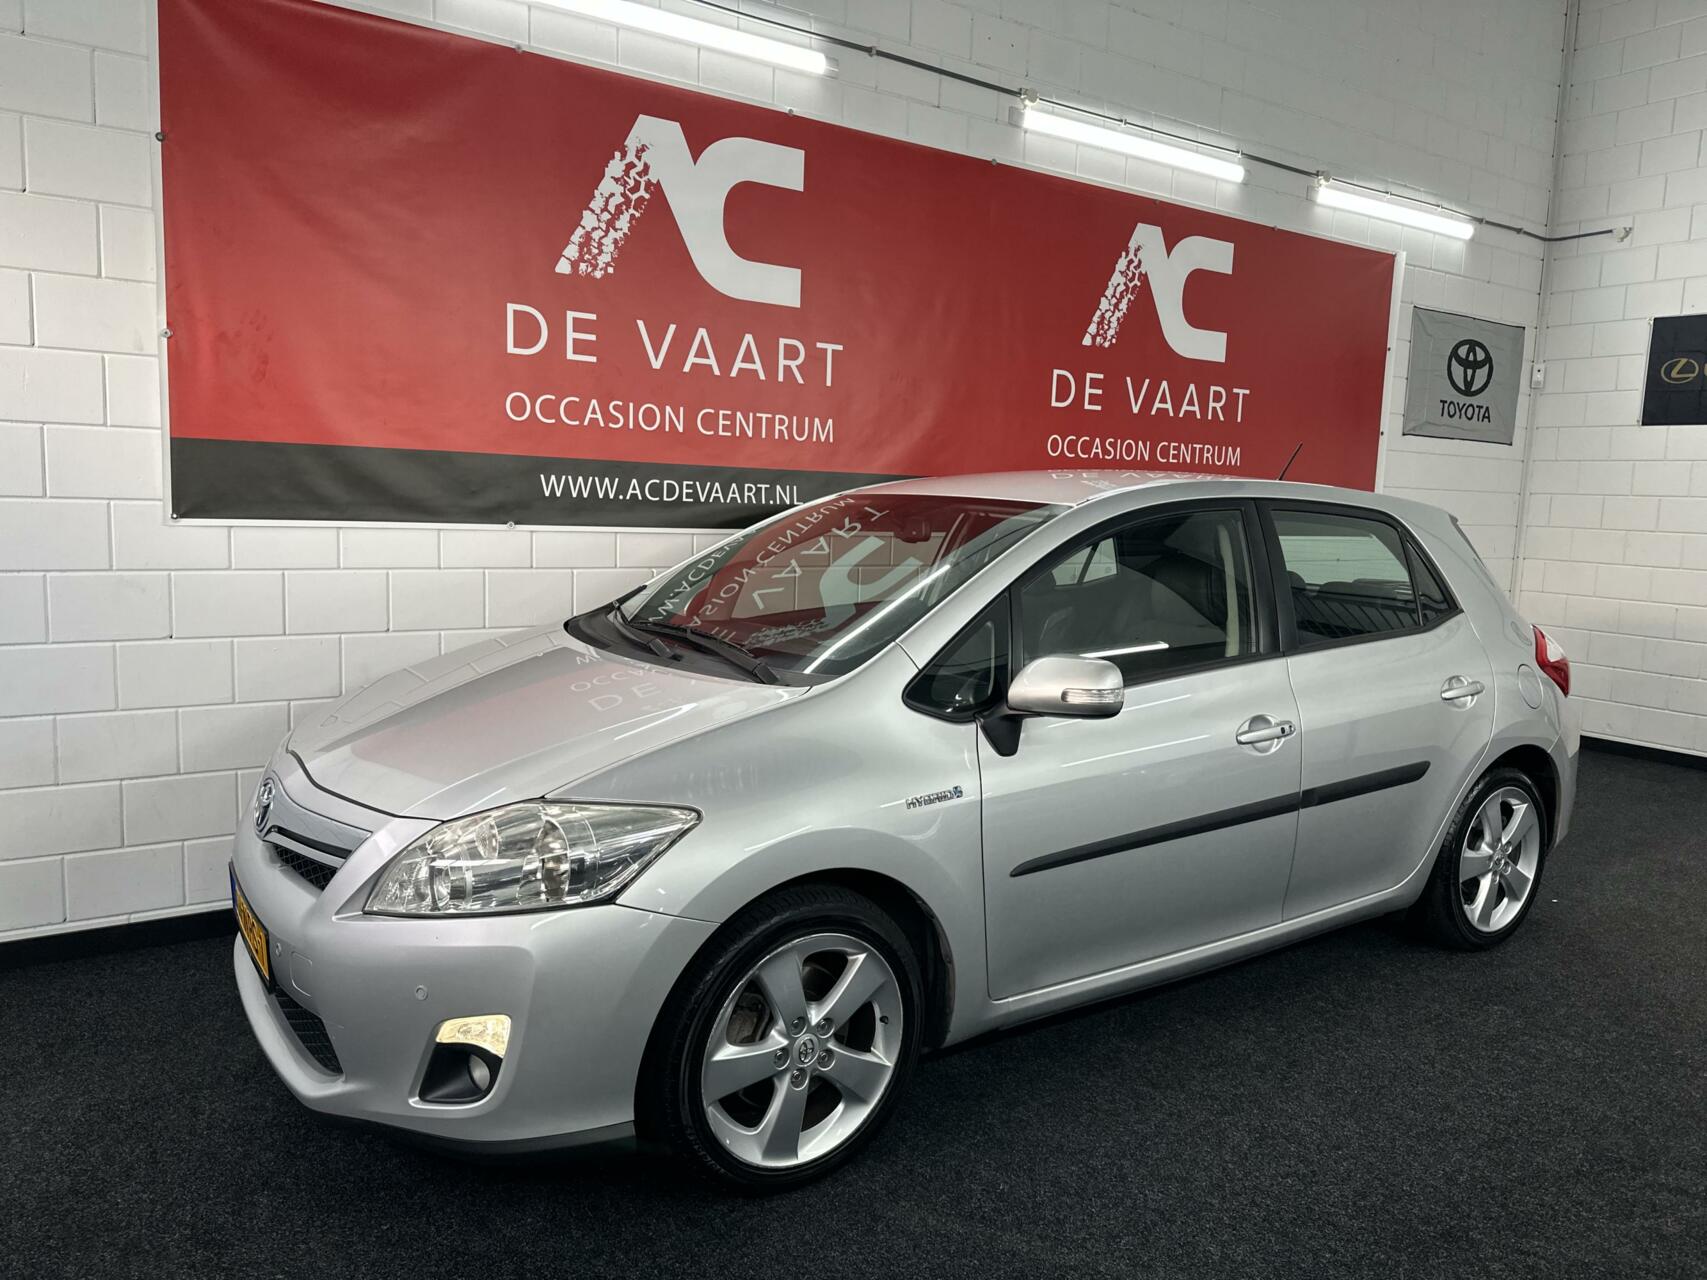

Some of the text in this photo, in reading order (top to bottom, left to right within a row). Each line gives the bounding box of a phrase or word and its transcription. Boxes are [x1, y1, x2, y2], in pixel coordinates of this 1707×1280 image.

[506, 302, 844, 387] DE VAART
[1050, 368, 1250, 423] DE VAART
[1439, 399, 1491, 423] TOYOTA
[505, 391, 835, 444] OCCASION CENTRUM
[1047, 434, 1241, 466] OCCASION CENTRUM
[540, 474, 804, 505] WWW.ACDEVAART.NL
